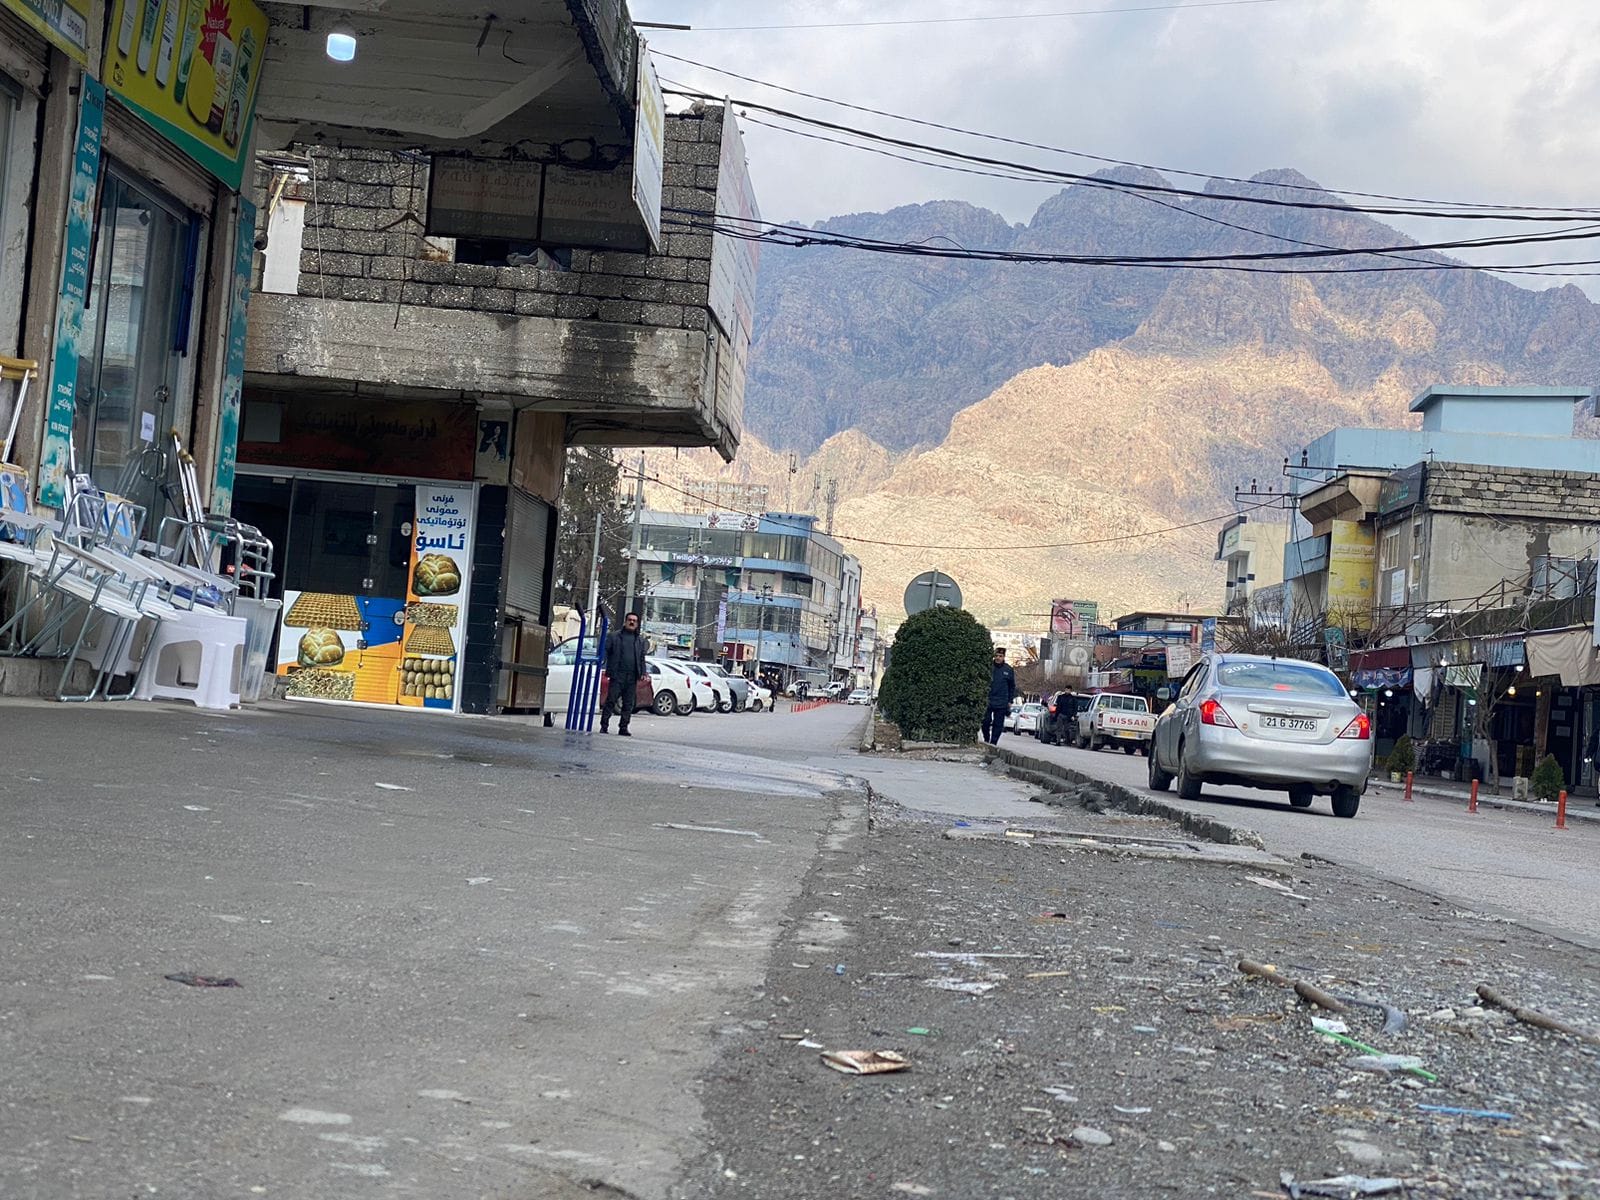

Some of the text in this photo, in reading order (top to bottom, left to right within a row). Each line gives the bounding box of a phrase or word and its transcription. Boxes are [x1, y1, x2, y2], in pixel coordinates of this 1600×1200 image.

[1225, 663, 1257, 674] 2012
[1109, 716, 1148, 727] NISSAN
[1266, 717, 1315, 730] 21 G 37765
